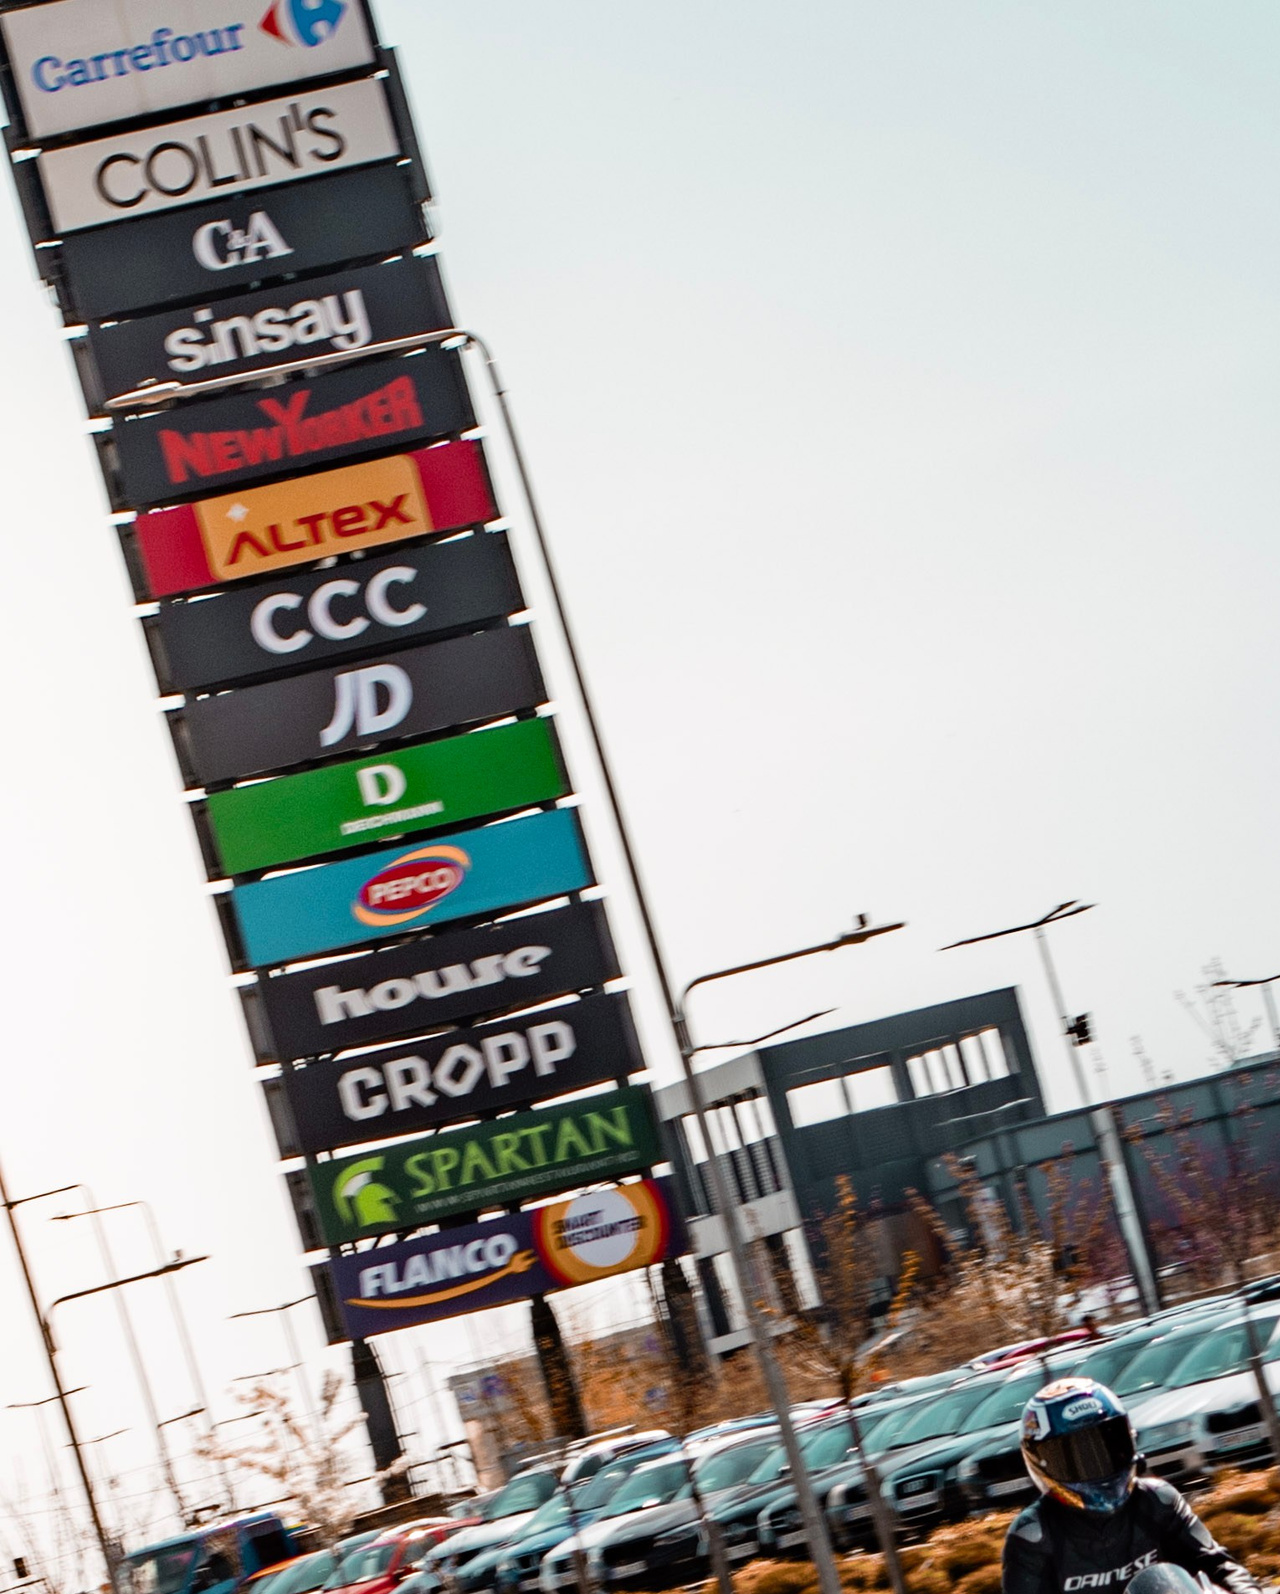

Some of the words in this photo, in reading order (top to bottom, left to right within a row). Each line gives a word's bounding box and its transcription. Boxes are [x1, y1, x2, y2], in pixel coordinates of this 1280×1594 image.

[31, 20, 246, 94] Carrefour
[93, 102, 347, 208] COLIN'S
[192, 210, 294, 271] C&A
[163, 289, 373, 373] sinsay
[250, 565, 428, 655] CCC
[318, 662, 413, 748] JD
[356, 764, 408, 806] D
[367, 866, 458, 906] PEPCO
[314, 945, 553, 1026] house
[337, 1020, 577, 1122] CROPP
[403, 1105, 634, 1199] SPARTAN
[358, 1232, 519, 1299] FLANCO
[1063, 1549, 1158, 1592] DAINESE
